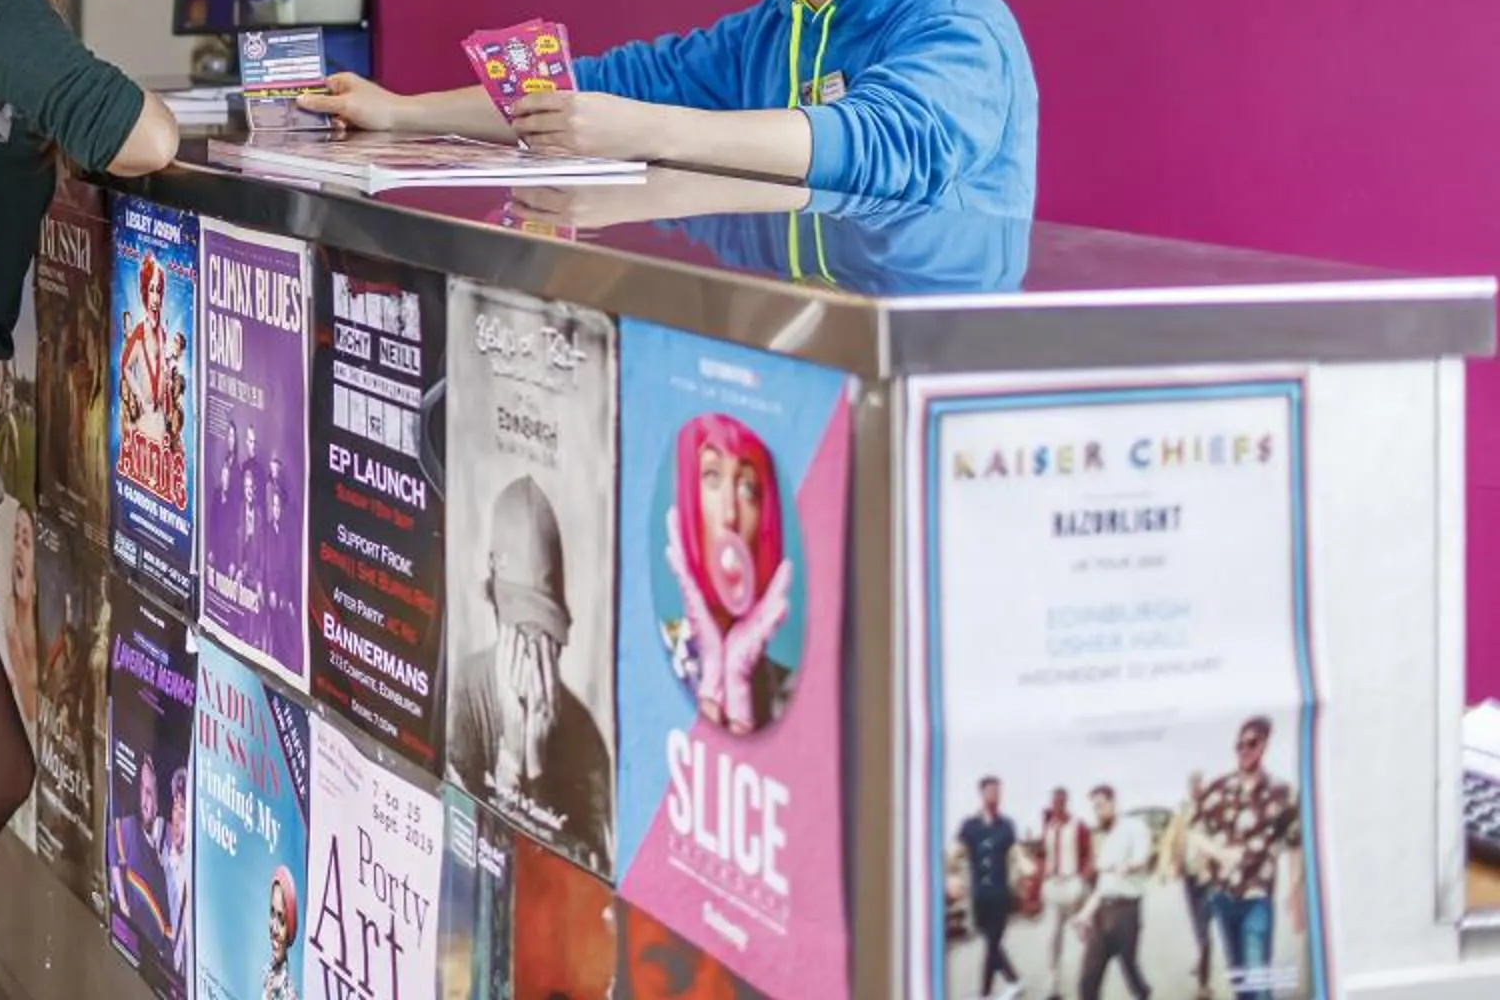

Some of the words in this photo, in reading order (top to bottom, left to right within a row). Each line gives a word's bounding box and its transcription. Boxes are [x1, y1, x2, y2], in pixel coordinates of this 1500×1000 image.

[208, 253, 254, 319] CLIMAX
[255, 266, 301, 333] BLUES
[208, 310, 243, 372] BAND
[380, 338, 421, 375] NEILL
[329, 443, 351, 475] EP
[353, 453, 427, 511] LAUNCH
[953, 440, 1105, 479] KAISER
[1128, 433, 1273, 469] CHIEFS
[1052, 504, 1183, 538] RAZORLIGHT
[323, 611, 430, 697] BANNERMANS
[198, 755, 254, 833] Finding
[256, 798, 282, 855] My
[198, 798, 239, 857] Voice
[666, 727, 791, 896] SLICE
[405, 824, 434, 857] 2019
[309, 833, 405, 1000] Art
[357, 824, 431, 949] Porty
